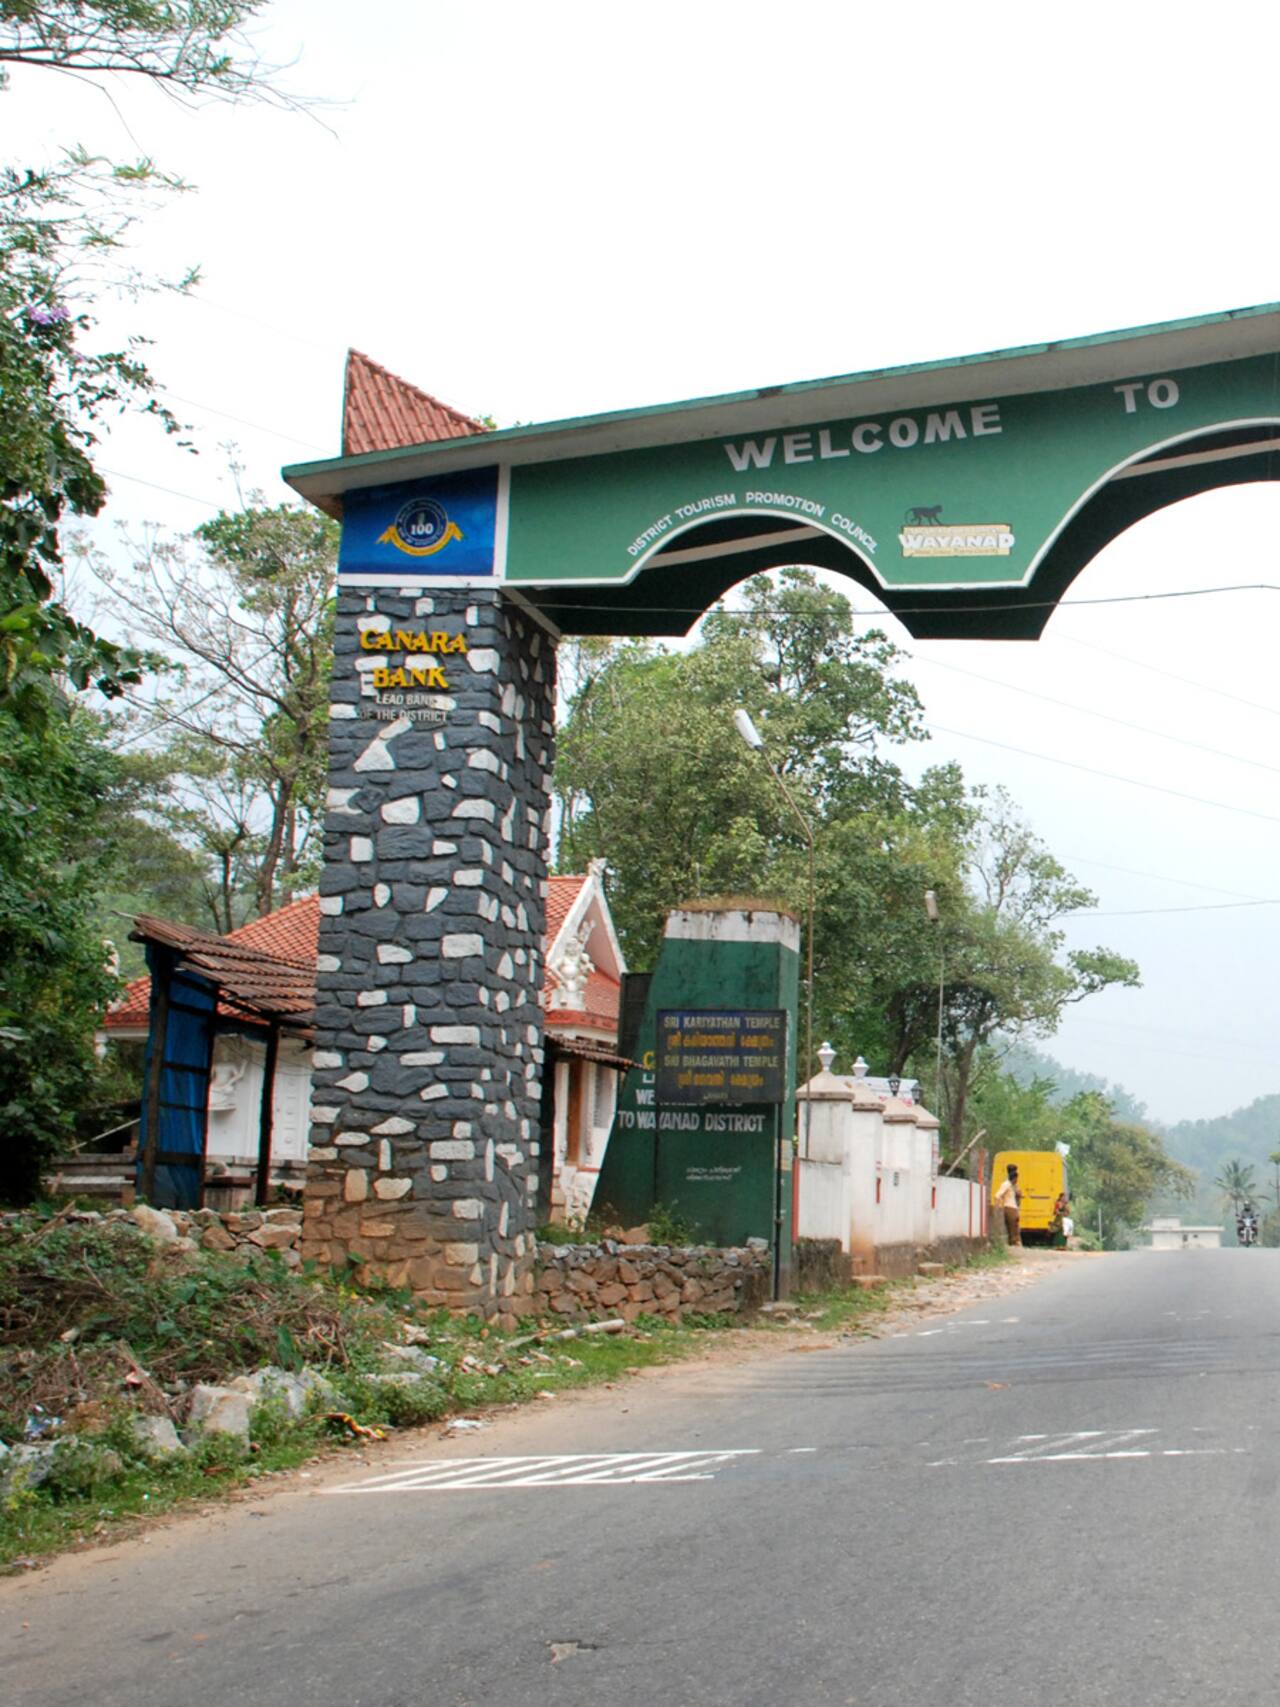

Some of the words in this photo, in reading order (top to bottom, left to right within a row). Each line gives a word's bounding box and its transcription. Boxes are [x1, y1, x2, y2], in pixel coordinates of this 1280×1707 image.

[723, 404, 1003, 472] WELCOME
[1113, 379, 1180, 414] TO
[410, 523, 434, 536] 100
[627, 514, 674, 556] DISTRICT
[675, 493, 736, 519] TOURISM
[746, 491, 826, 517] PROMOTION
[831, 513, 878, 554] COUNCIL
[898, 533, 1015, 549] WAYANAD
[360, 629, 468, 654] CANARA
[373, 667, 449, 688] BANK
[375, 693, 404, 705] LEAD
[406, 694, 439, 706] BANK
[376, 709, 396, 720] THE
[399, 710, 448, 722] DISTRICT
[745, 1016, 780, 1029] TEMPLE
[743, 1055, 779, 1068] TEMPLE
[618, 1111, 635, 1128] TO
[704, 1113, 766, 1132] DISTRICT
